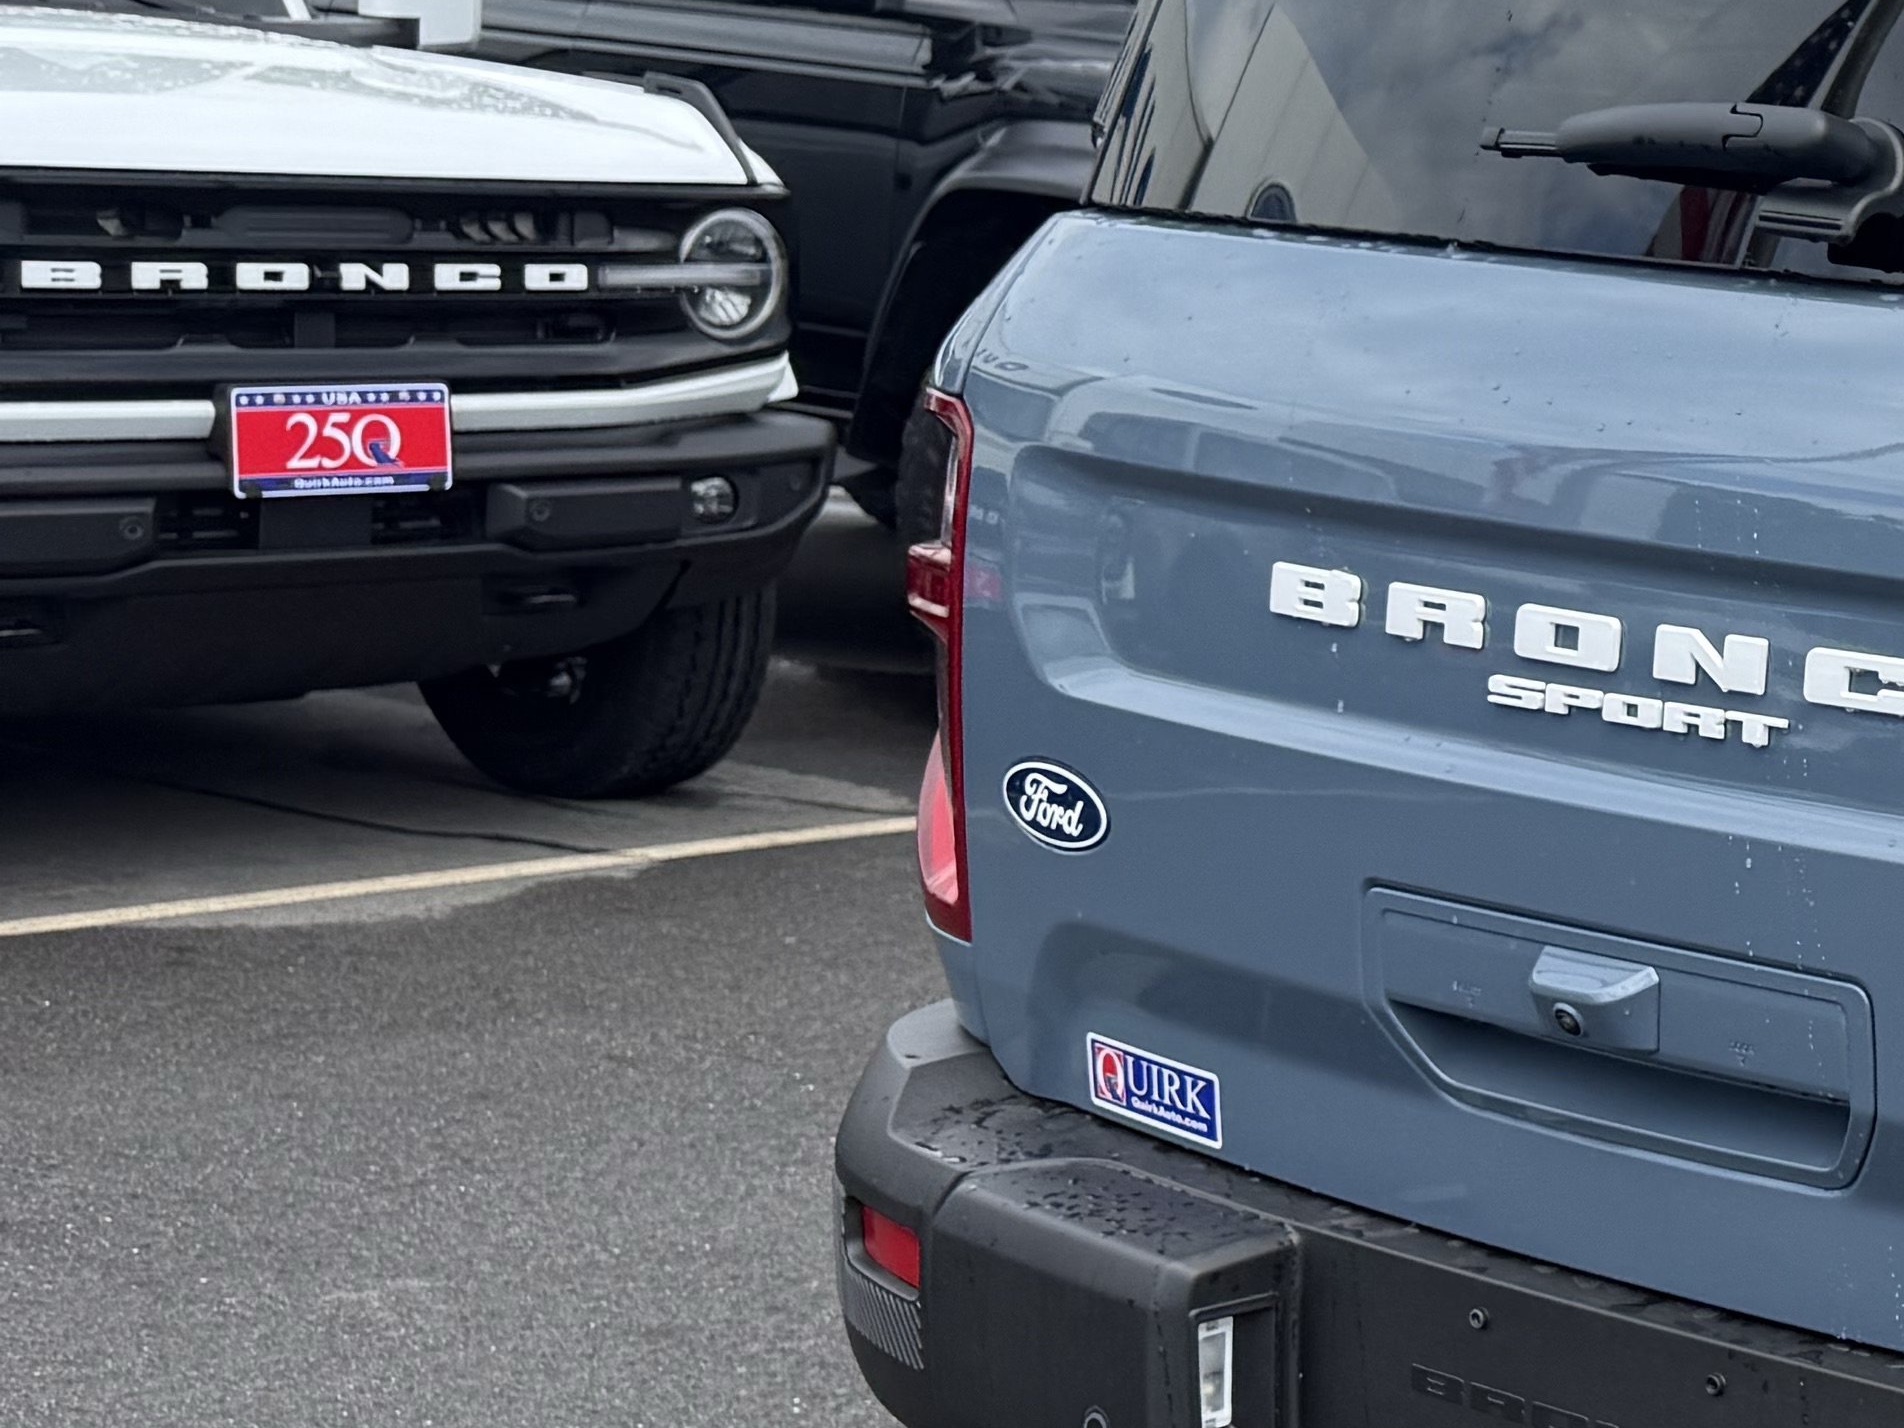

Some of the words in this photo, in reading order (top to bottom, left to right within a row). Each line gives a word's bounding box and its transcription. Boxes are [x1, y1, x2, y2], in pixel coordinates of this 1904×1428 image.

[20, 258, 590, 292] BRONCO
[1485, 673, 1790, 748] SPORT
[1020, 772, 1084, 837] Ford
[1093, 1042, 1212, 1121] QUIRK
